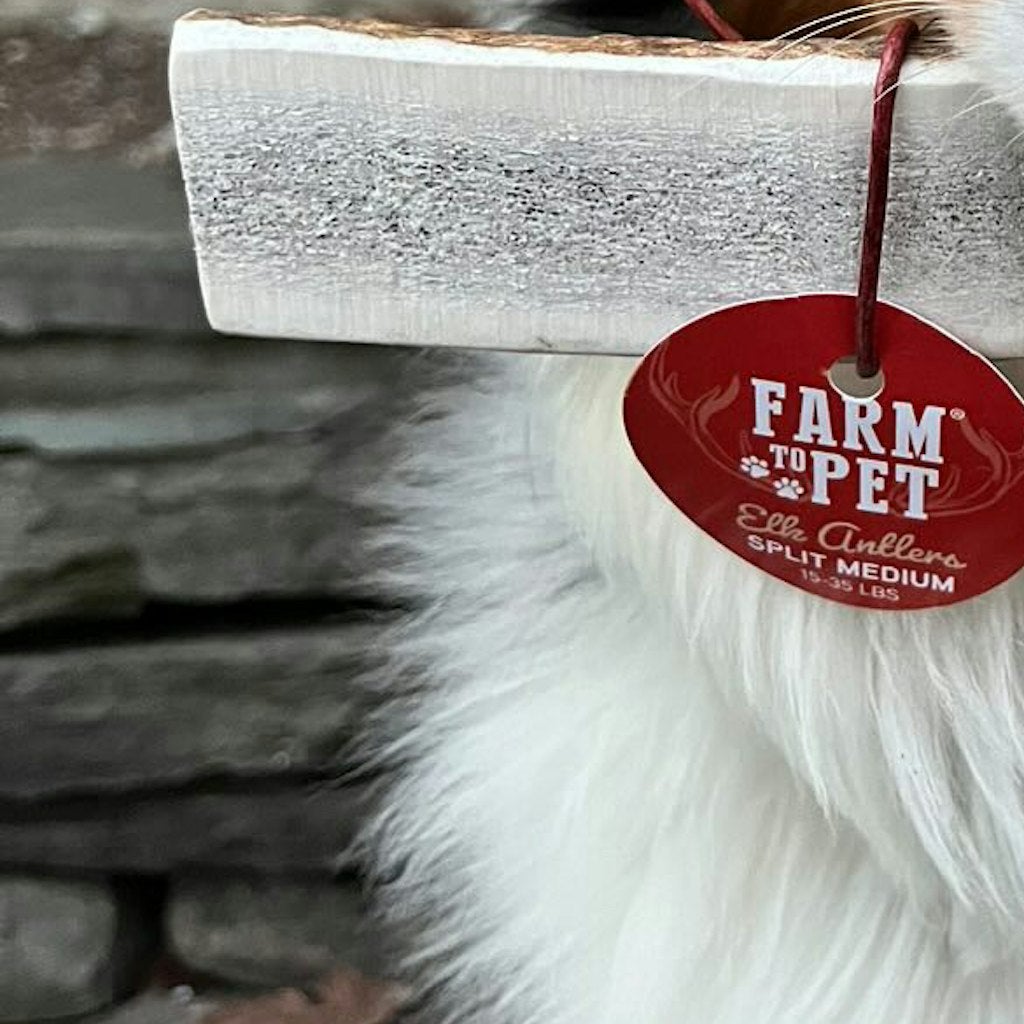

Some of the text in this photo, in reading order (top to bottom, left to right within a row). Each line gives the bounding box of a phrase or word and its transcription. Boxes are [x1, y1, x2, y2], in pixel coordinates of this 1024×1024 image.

[769, 444, 939, 520] TO PET
[736, 502, 967, 569] Elk Antlers
[747, 535, 956, 594] SPLIT MEDIUM
[858, 579, 900, 602] LBS
